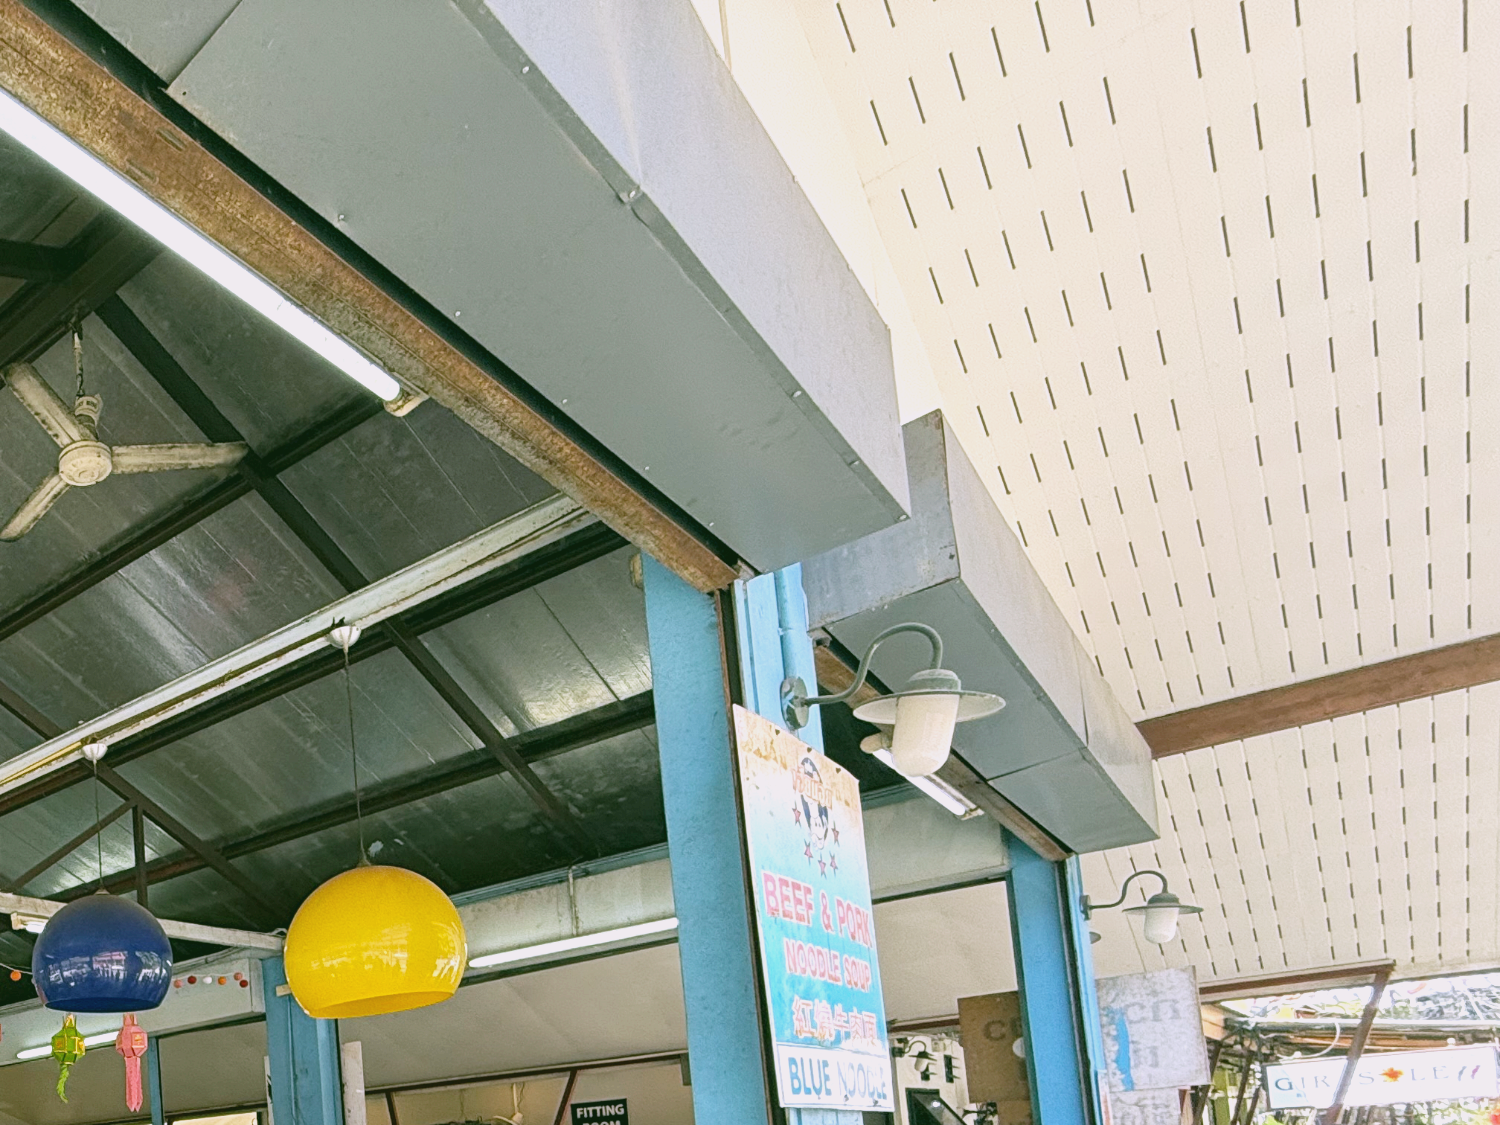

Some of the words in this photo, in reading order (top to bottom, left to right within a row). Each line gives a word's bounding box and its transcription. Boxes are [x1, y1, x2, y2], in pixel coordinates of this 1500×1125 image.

[762, 872, 813, 926] BEEF
[820, 891, 835, 934] &
[835, 897, 872, 949] PORK
[784, 938, 842, 985] NOODLE
[843, 955, 871, 992] SOUP
[788, 1056, 832, 1096] BLUE
[836, 1061, 888, 1100] NOODLE
[576, 1103, 625, 1119] FITTING
